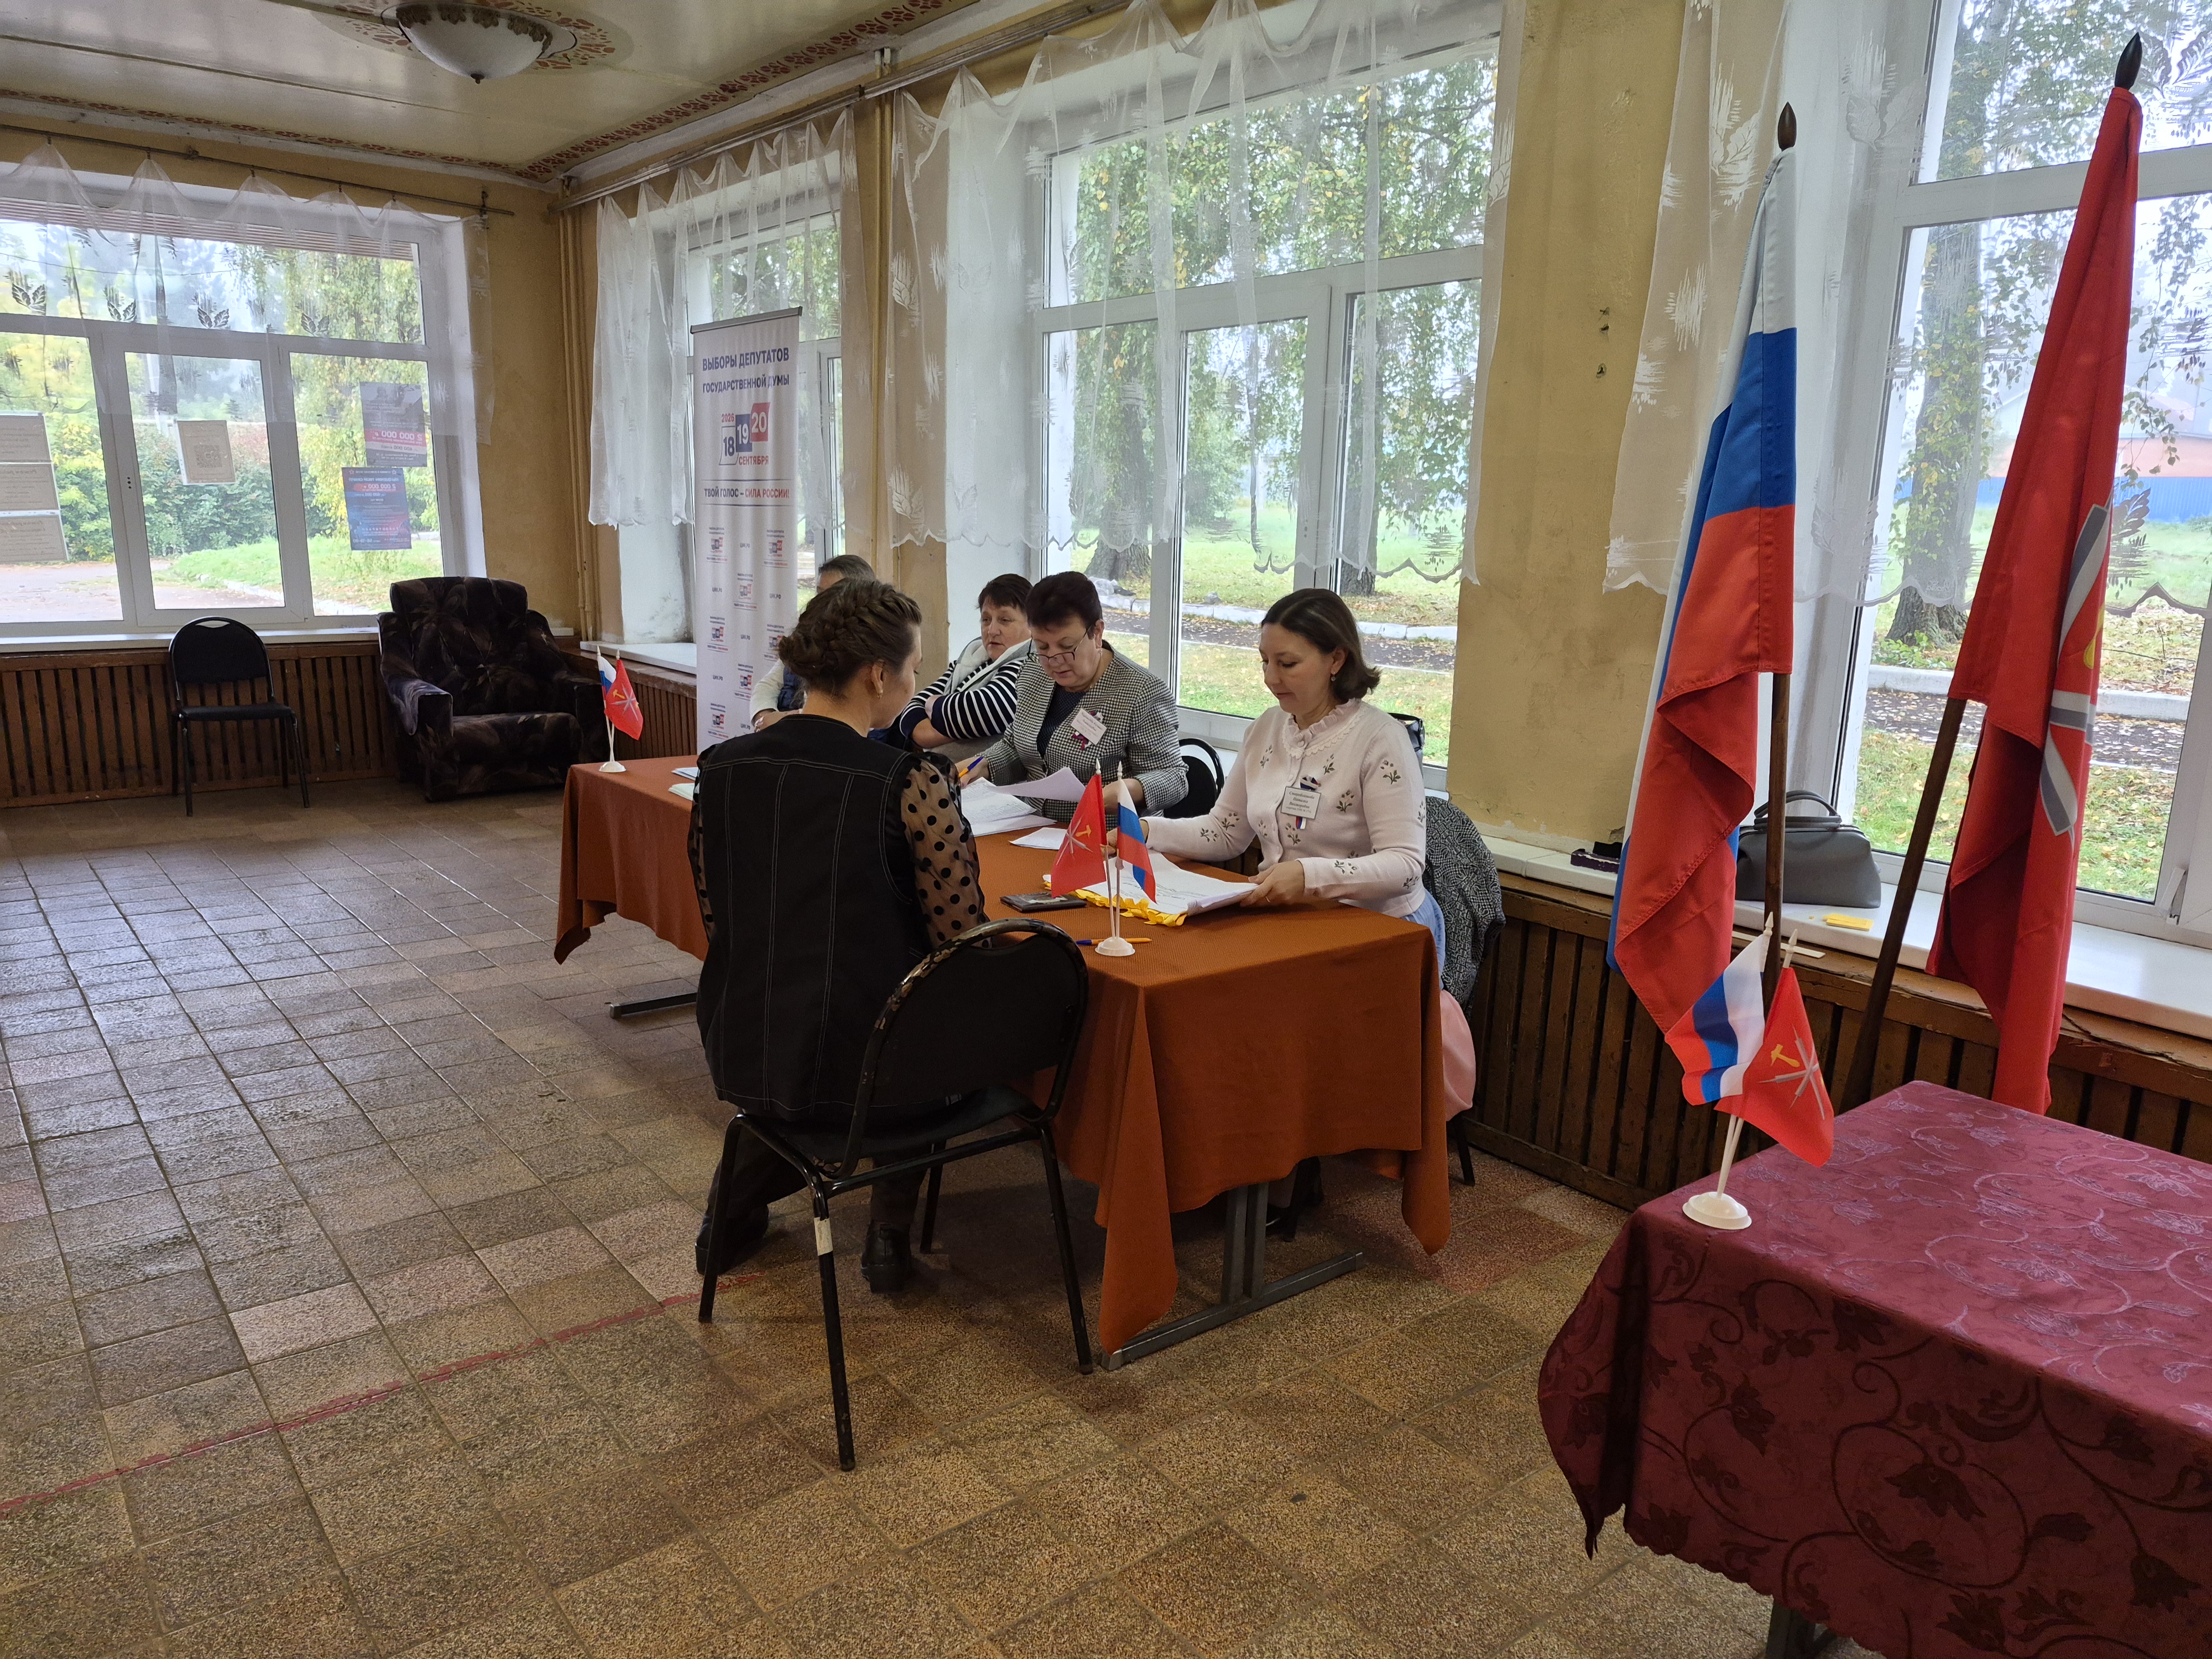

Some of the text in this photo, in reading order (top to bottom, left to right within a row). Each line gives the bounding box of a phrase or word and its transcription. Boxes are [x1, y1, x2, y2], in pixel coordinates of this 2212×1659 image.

[703, 347, 789, 371] ВЫБОРЫ ДЕПУТАТОВ
[703, 374, 789, 393] ГОСУДАРСТВЕННОЙ ДУМЫ
[722, 413, 734, 422] 2026
[723, 411, 767, 457] 18 19 20
[739, 456, 769, 465] СЕНТЯБРЯ
[705, 486, 719, 498] ТВОЙ
[720, 488, 739, 498] ГОЛОС
[745, 488, 761, 498] СИЛА
[763, 488, 790, 498] РОССИИ!
